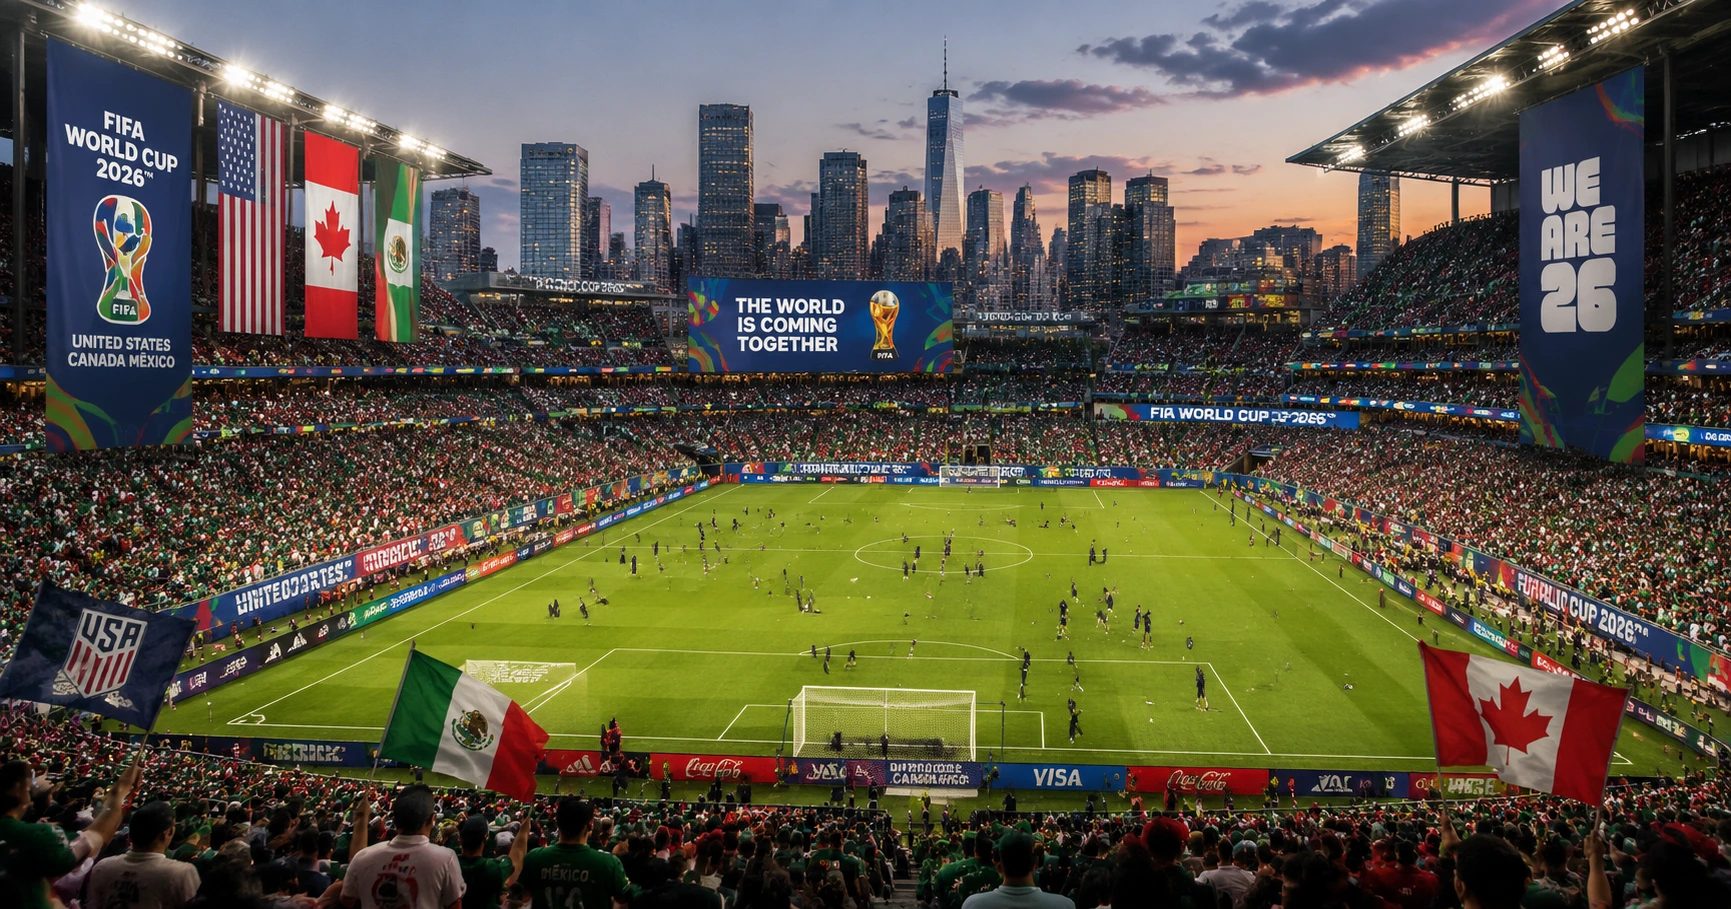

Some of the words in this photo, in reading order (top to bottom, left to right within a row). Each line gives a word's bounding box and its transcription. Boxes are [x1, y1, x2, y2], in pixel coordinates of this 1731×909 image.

[104, 110, 145, 141] FIFA
[65, 123, 138, 162] WORLD
[142, 147, 178, 173] CUP
[1541, 156, 1600, 214] WE
[1541, 205, 1616, 261] ARE
[1540, 257, 1617, 333] 26
[735, 298, 771, 313] THE
[776, 298, 845, 314] WORLD
[737, 317, 756, 332] IS
[760, 317, 837, 333] COMING
[72, 334, 122, 350] UNITED
[126, 336, 171, 352] STATES
[737, 336, 838, 352] TOGETHER
[67, 352, 125, 367] CANADA
[1178, 407, 1233, 421] WORLD
[1238, 409, 1269, 422] CUP
[81, 613, 142, 653] USA
[1033, 768, 1083, 786] VISA
